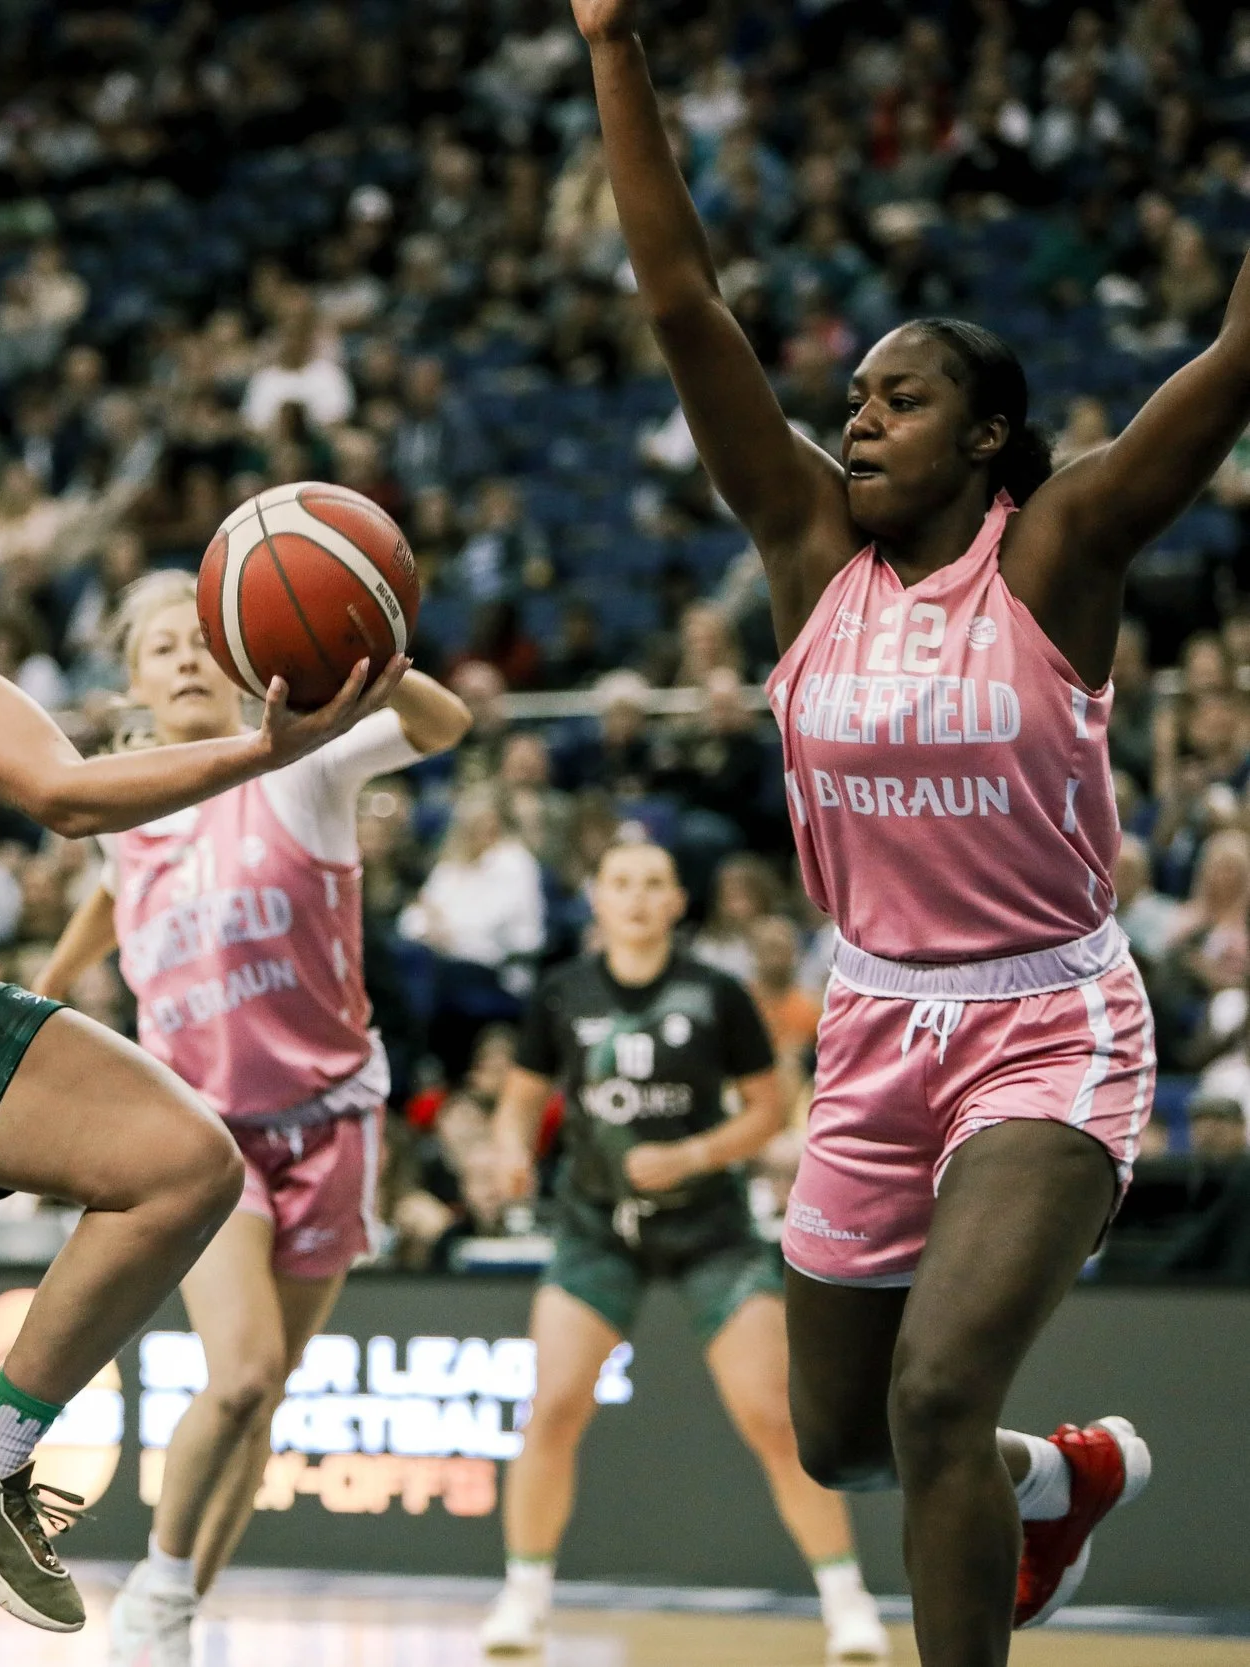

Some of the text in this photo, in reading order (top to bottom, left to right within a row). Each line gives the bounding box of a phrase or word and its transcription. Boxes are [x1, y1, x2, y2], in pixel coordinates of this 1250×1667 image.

[866, 601, 947, 673] 22
[796, 673, 1021, 745] SHEFFIELD
[846, 775, 1010, 818] BRAUN
